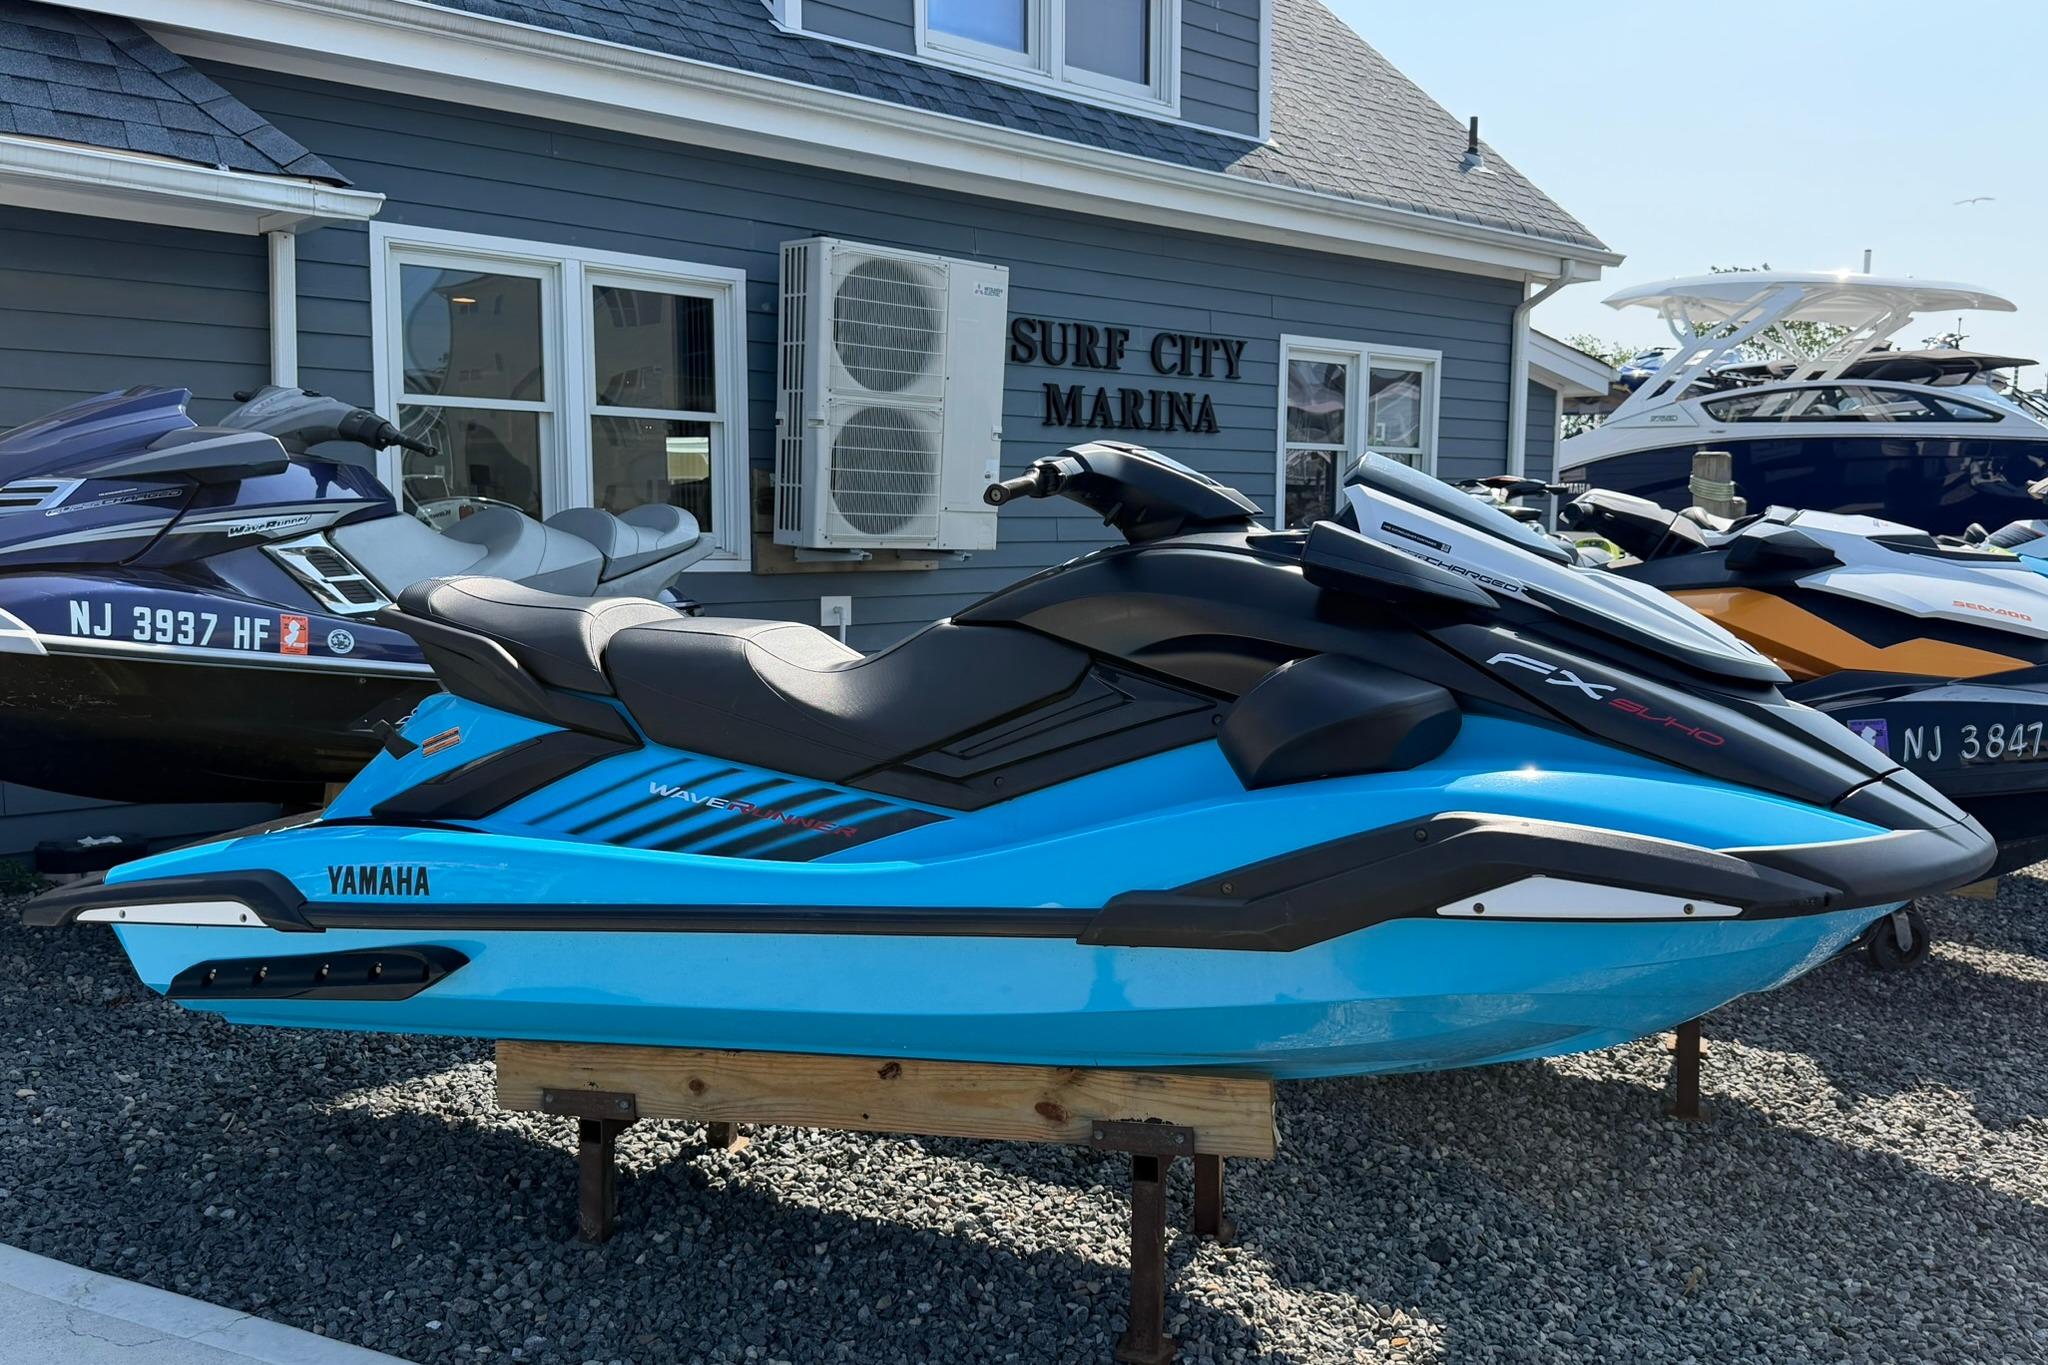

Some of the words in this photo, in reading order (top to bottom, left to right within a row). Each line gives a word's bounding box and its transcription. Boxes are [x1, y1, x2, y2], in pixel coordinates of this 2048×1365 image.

[1011, 317, 1130, 370] SURF
[1151, 332, 1248, 379] CITY
[1042, 382, 1221, 433] MARINA
[228, 514, 312, 537] WaveRunner
[69, 600, 112, 637] NJ
[133, 606, 218, 646] 3937
[234, 616, 271, 650] HF
[1486, 652, 1617, 700] FX
[1609, 698, 1726, 746] SVHO
[1903, 725, 1942, 763] NJ
[1960, 721, 2044, 759] 3847
[650, 781, 858, 837] WAVERUNNER
[327, 865, 430, 896] YAMAHA
